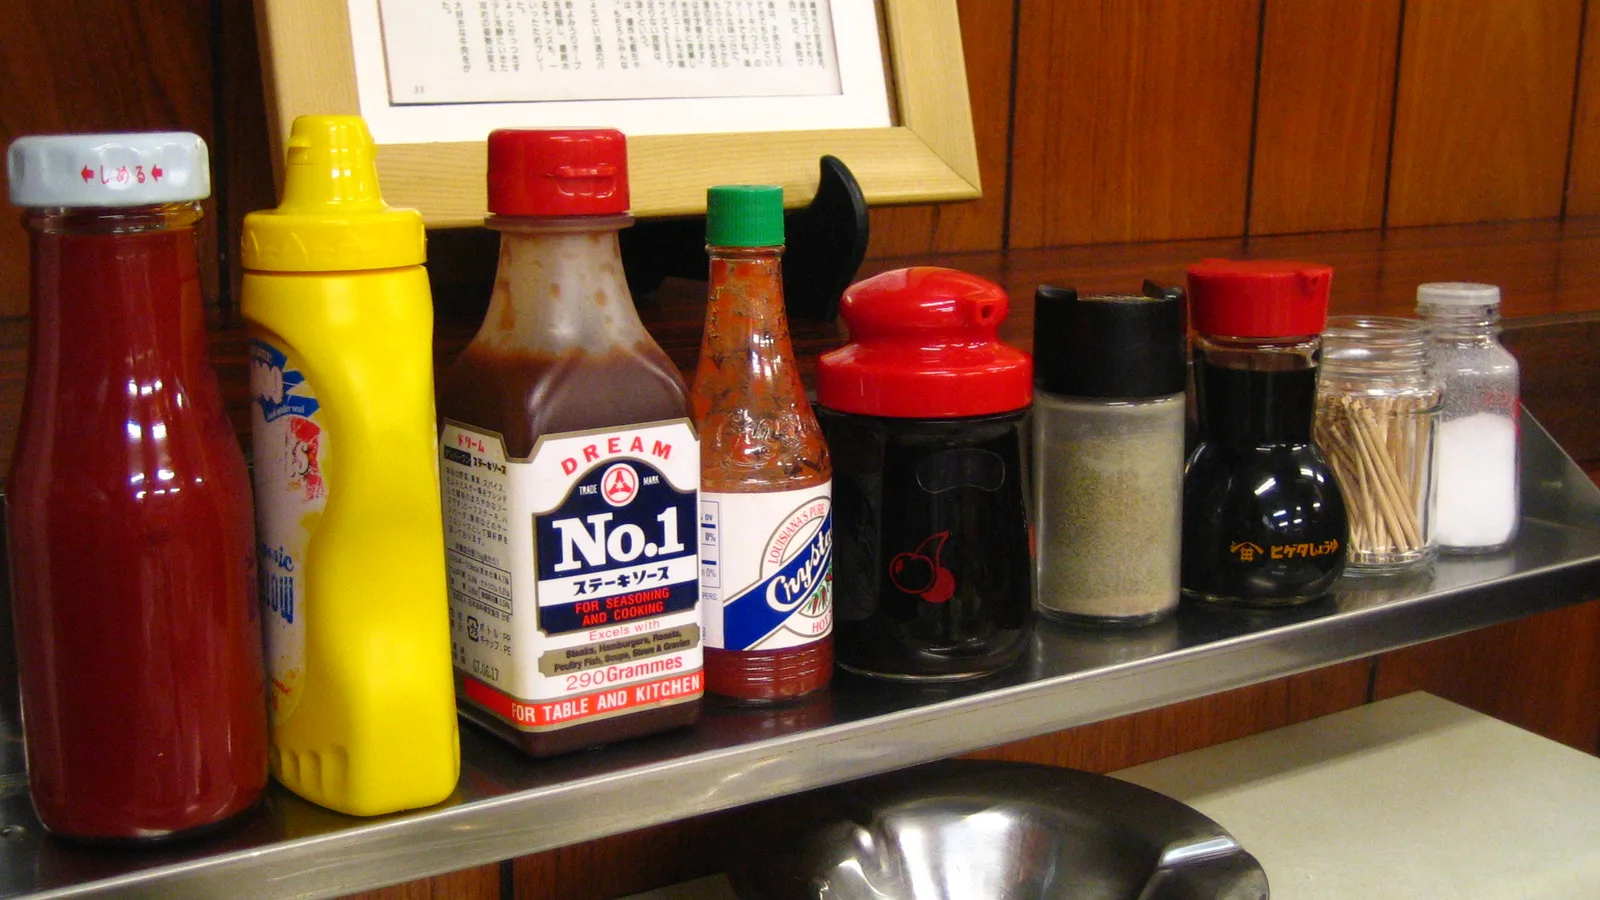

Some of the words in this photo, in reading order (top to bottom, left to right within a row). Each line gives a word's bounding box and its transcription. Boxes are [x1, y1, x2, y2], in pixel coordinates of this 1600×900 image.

[100, 164, 146, 185] しめる
[560, 436, 673, 476] DREAM
[579, 484, 598, 495] TRADE
[643, 474, 660, 485] MARK
[552, 506, 685, 572] No.1
[768, 510, 808, 564] LOUISIANA'S
[809, 503, 826, 518] PURE
[1270, 539, 1339, 559] ヒゲタしょうゆ
[573, 566, 670, 596] ステーキソース
[766, 527, 832, 612] Crysta
[575, 602, 599, 614] FOR
[606, 587, 671, 607] SEASONING
[582, 613, 608, 626] AND
[614, 601, 664, 620] COOKING
[566, 647, 597, 659] Steaks,
[599, 637, 651, 653] Hamburgers,
[653, 629, 682, 642] Roasts,
[589, 625, 630, 641] Excels
[635, 620, 661, 633] with
[554, 660, 582, 673] Poultry
[511, 703, 536, 723] FOR
[543, 697, 590, 721] TABLE
[597, 690, 627, 710] AND
[636, 674, 700, 702] KITCHEN
